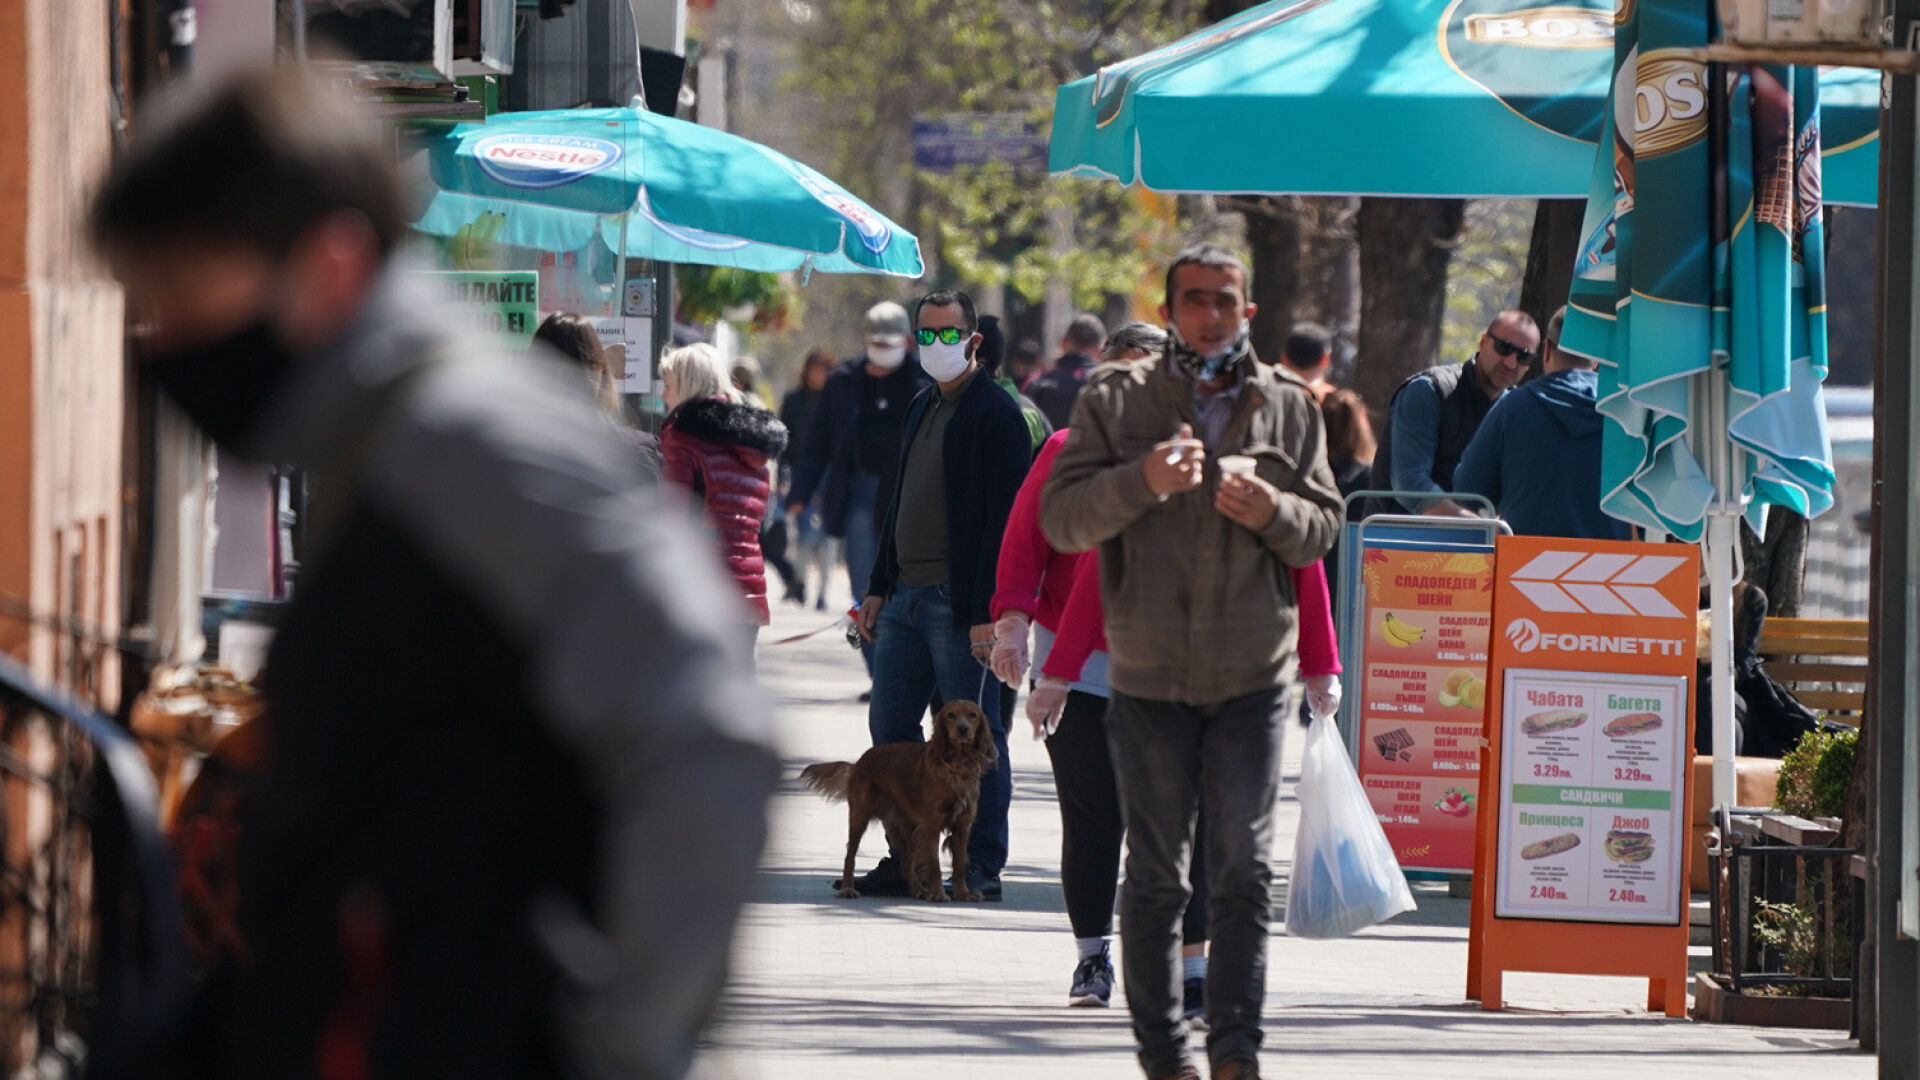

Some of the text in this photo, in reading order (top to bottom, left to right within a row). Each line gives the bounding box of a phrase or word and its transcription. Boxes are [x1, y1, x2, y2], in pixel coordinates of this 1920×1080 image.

[1485, 18, 1615, 39] BOS
[1635, 71, 1708, 132] OS
[1395, 575, 1477, 590] СЛАДОЛЕДЕН
[1417, 592, 1453, 606] ШЕЙК
[1439, 616, 1489, 626] СЛАДОЛЕДЕ
[1540, 634, 1682, 656] FORNETTI
[1372, 669, 1427, 680] СЛАДОЛЕДЕН
[1527, 690, 1584, 708] Чабата
[1608, 694, 1661, 711] Багета
[1367, 780, 1421, 789] СЛАДОЛЕДЕН
[1560, 789, 1623, 804] САНДВИЧИ
[1519, 812, 1584, 828] Принцеса
[1612, 816, 1649, 830] Джоб
